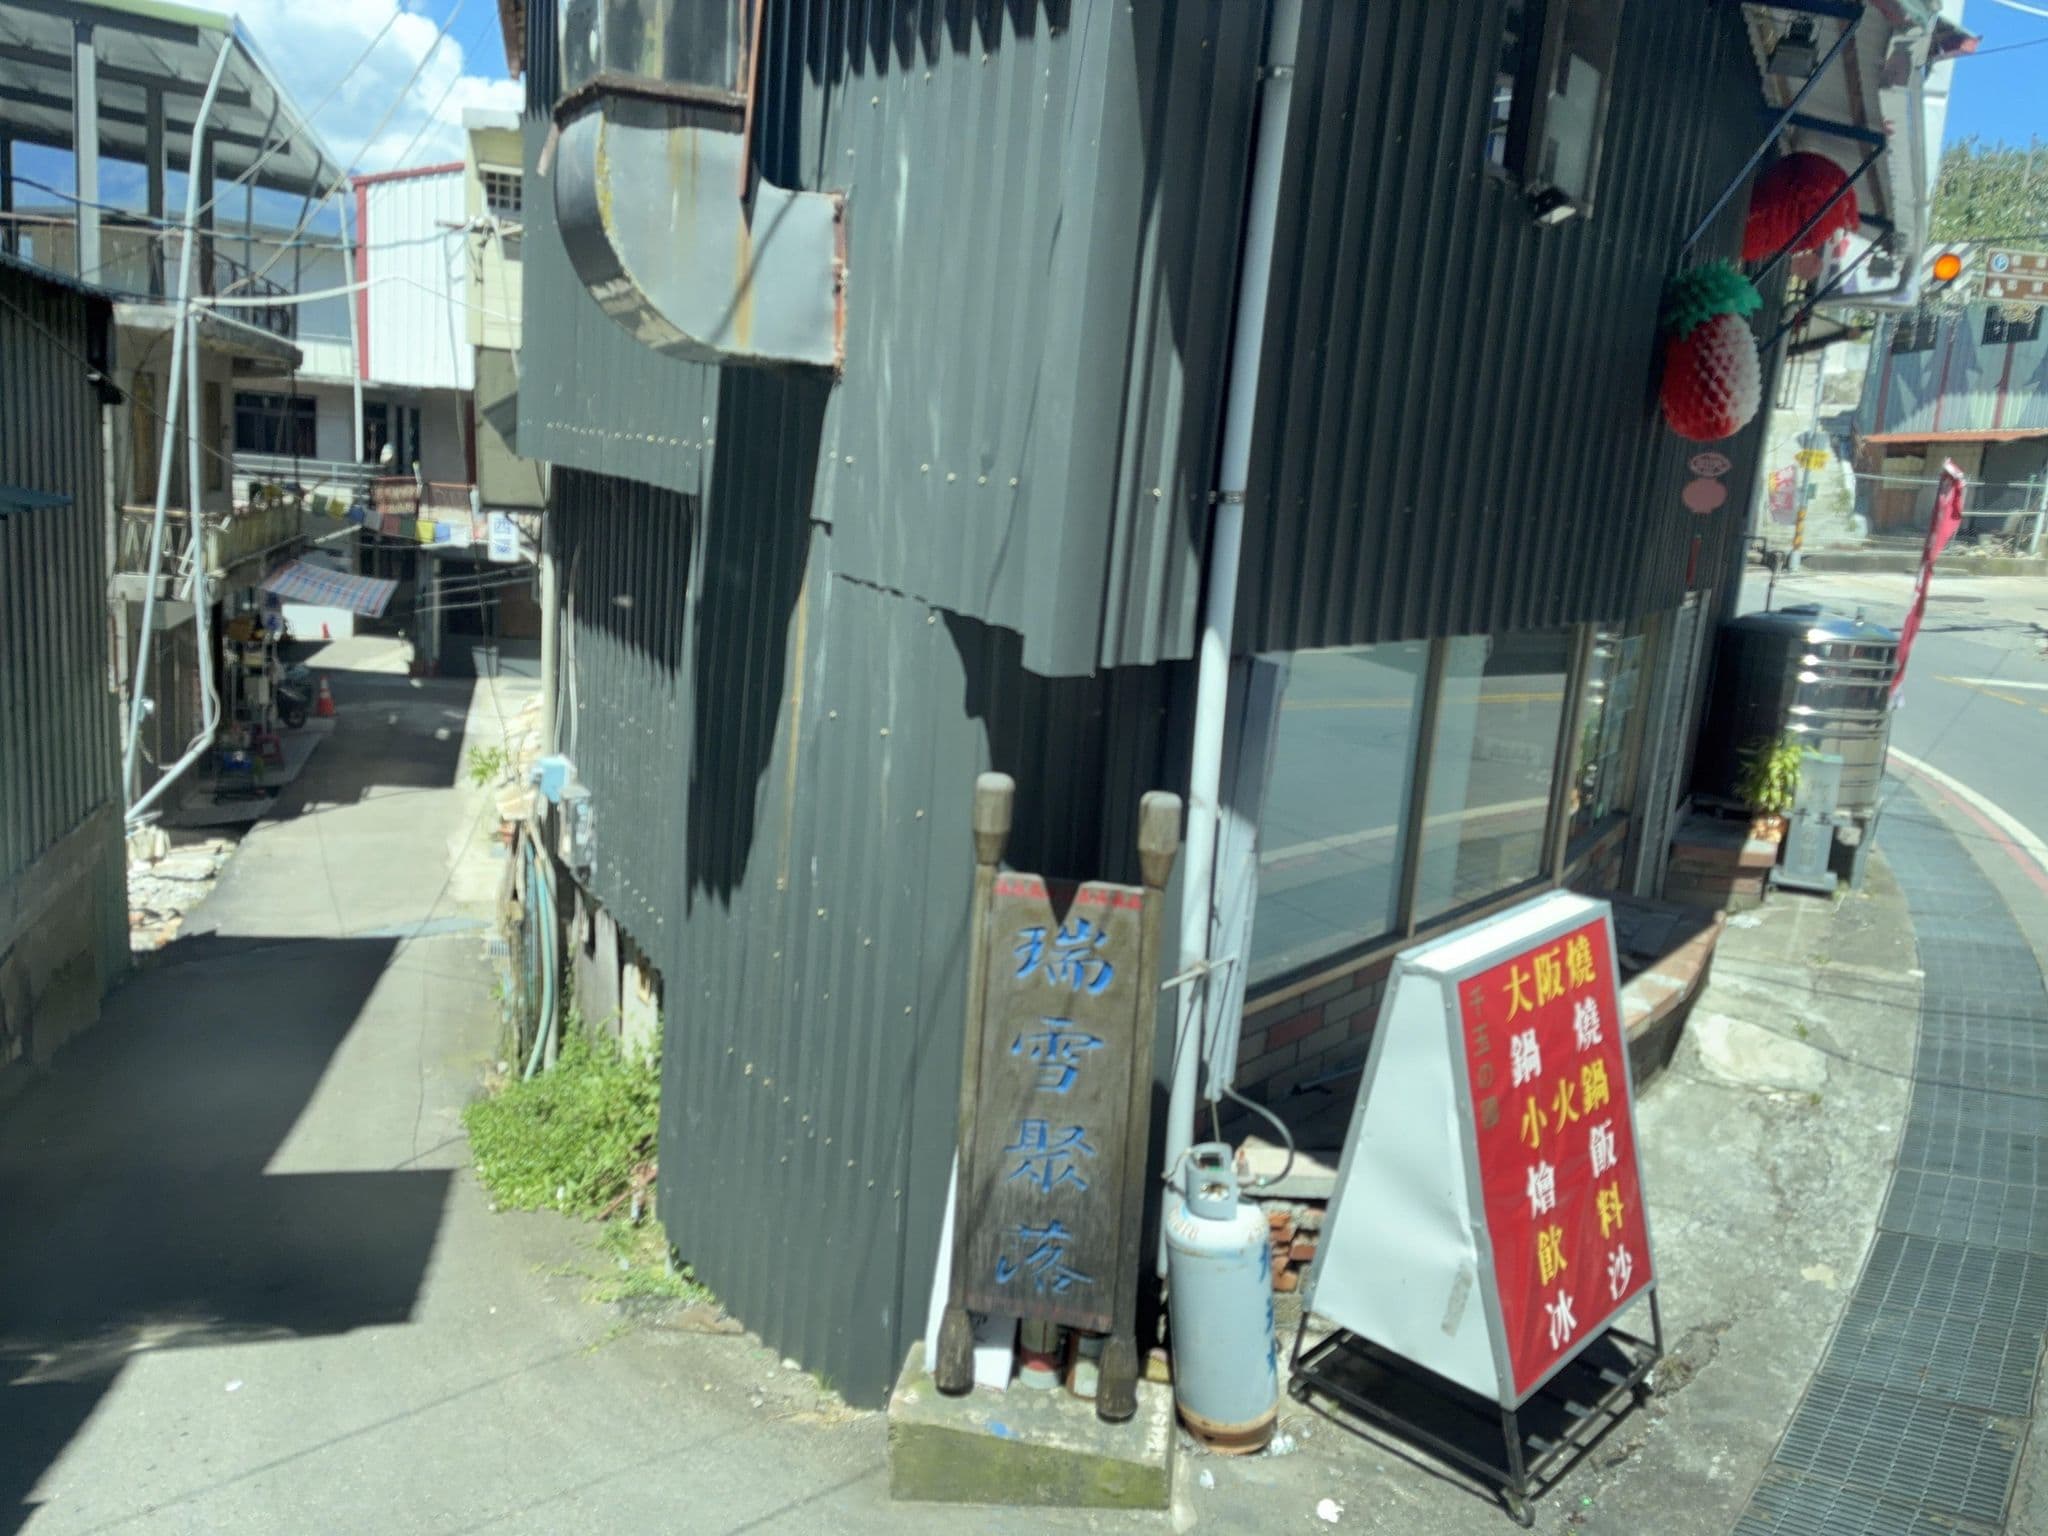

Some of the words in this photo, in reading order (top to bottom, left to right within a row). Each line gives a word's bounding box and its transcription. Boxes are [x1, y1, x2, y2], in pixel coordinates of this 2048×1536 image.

[1502, 934, 1596, 1022] 大阪燒
[997, 919, 1114, 1294] 瑞雪聚落
[1520, 1058, 1611, 1150] 小火鍋
